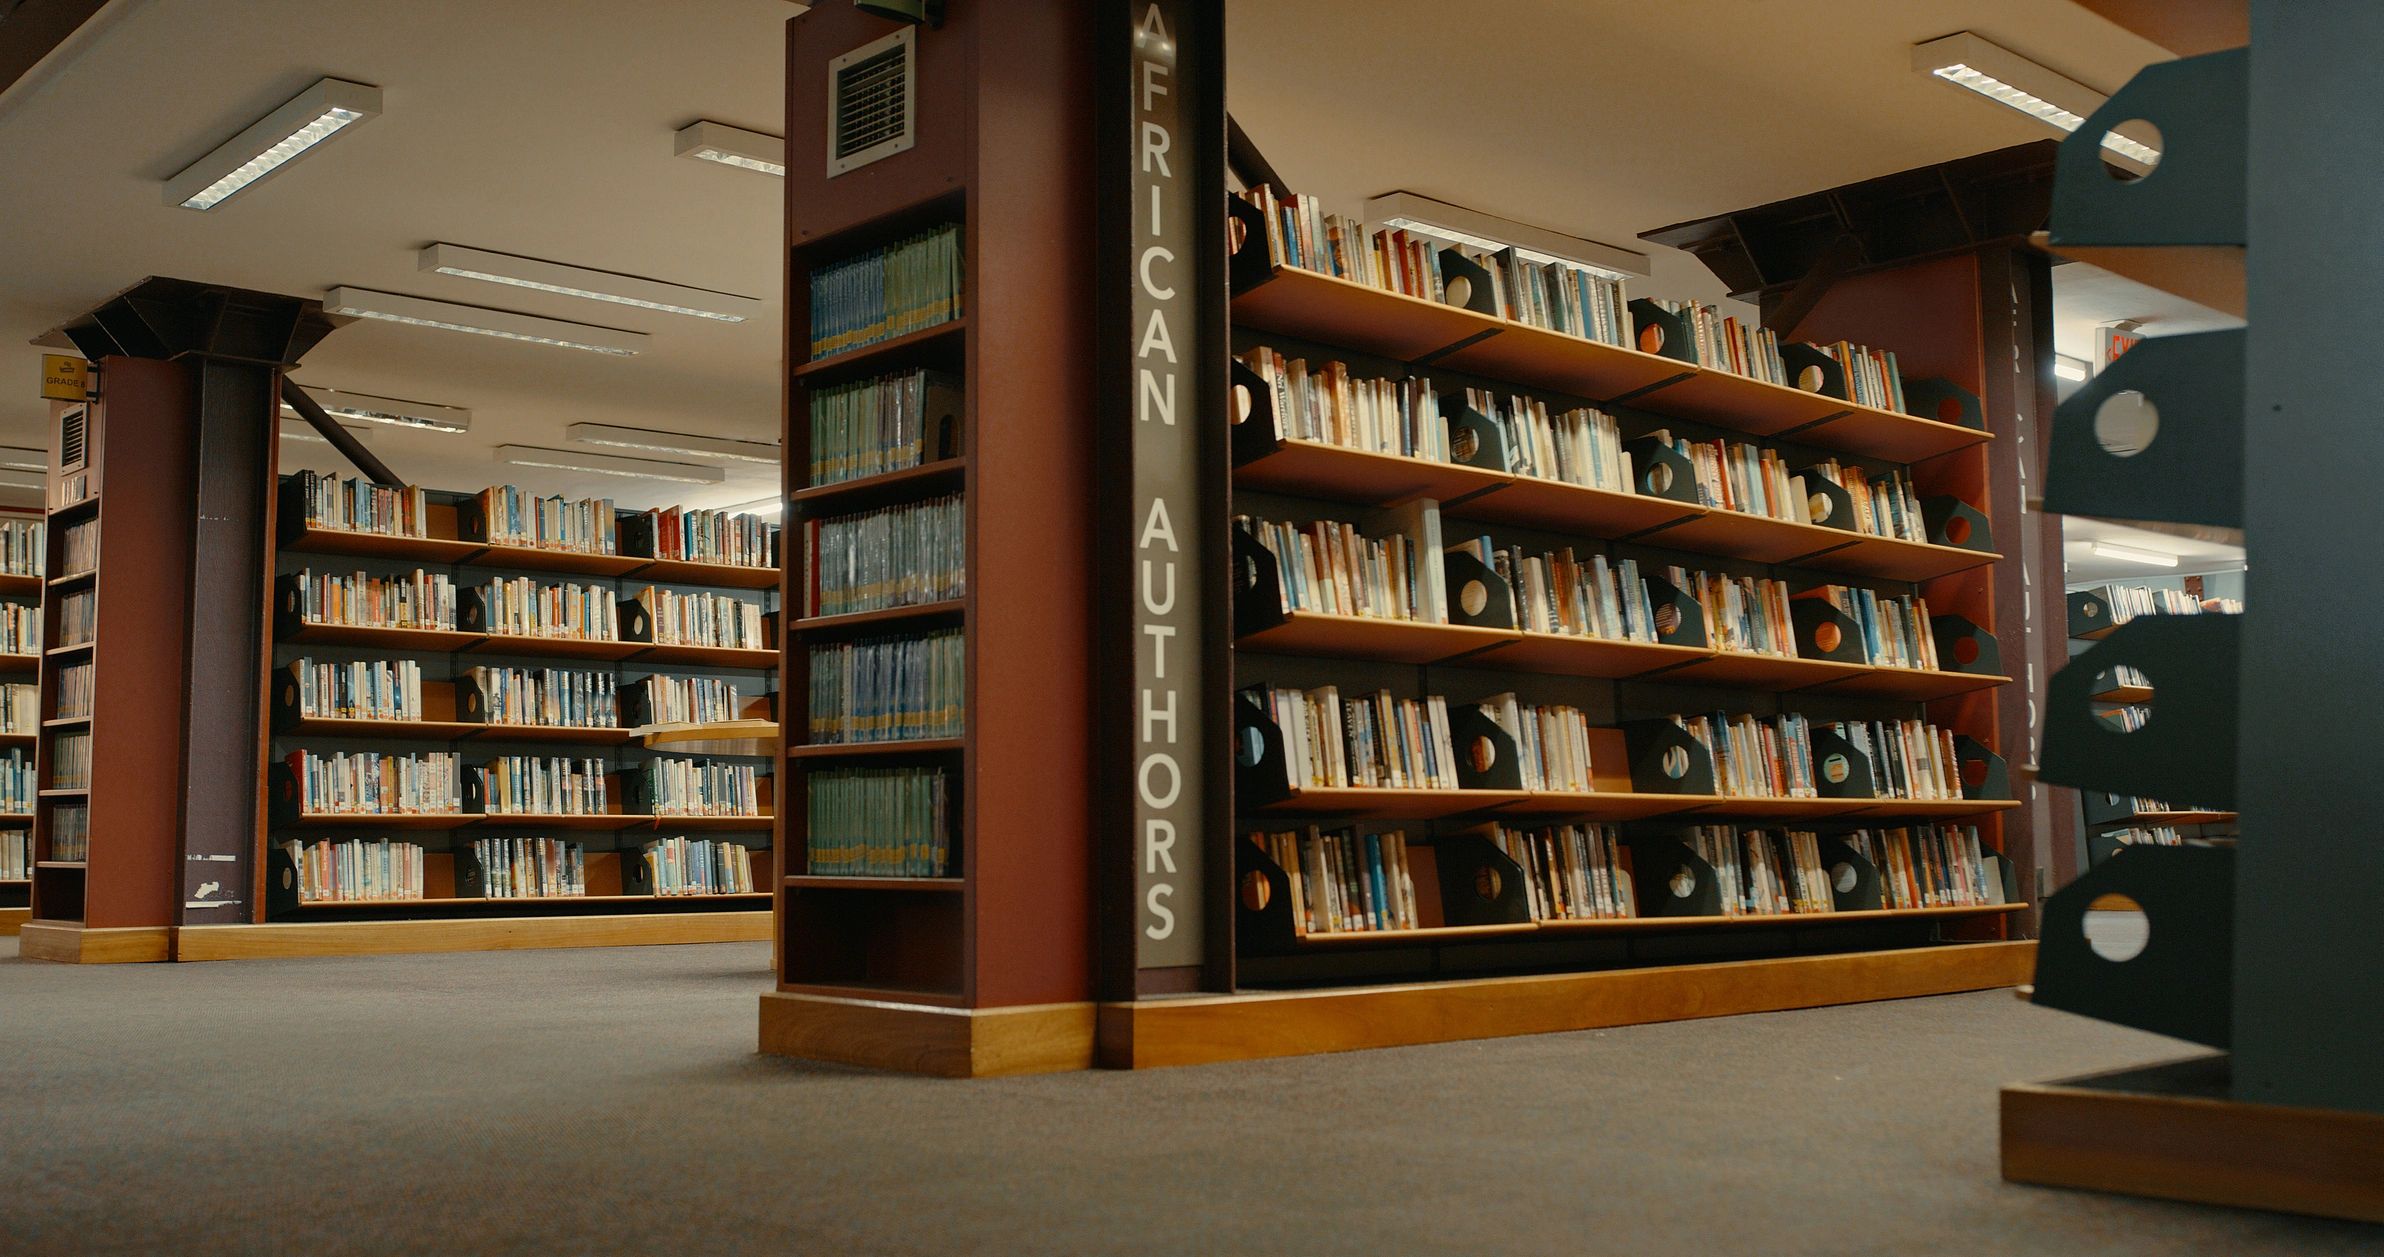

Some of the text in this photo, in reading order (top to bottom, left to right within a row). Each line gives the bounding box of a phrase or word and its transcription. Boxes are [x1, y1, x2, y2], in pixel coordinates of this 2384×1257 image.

[46, 376, 79, 388] GRADE
[1138, 3, 1182, 941] AFRICAN AUTHORS
